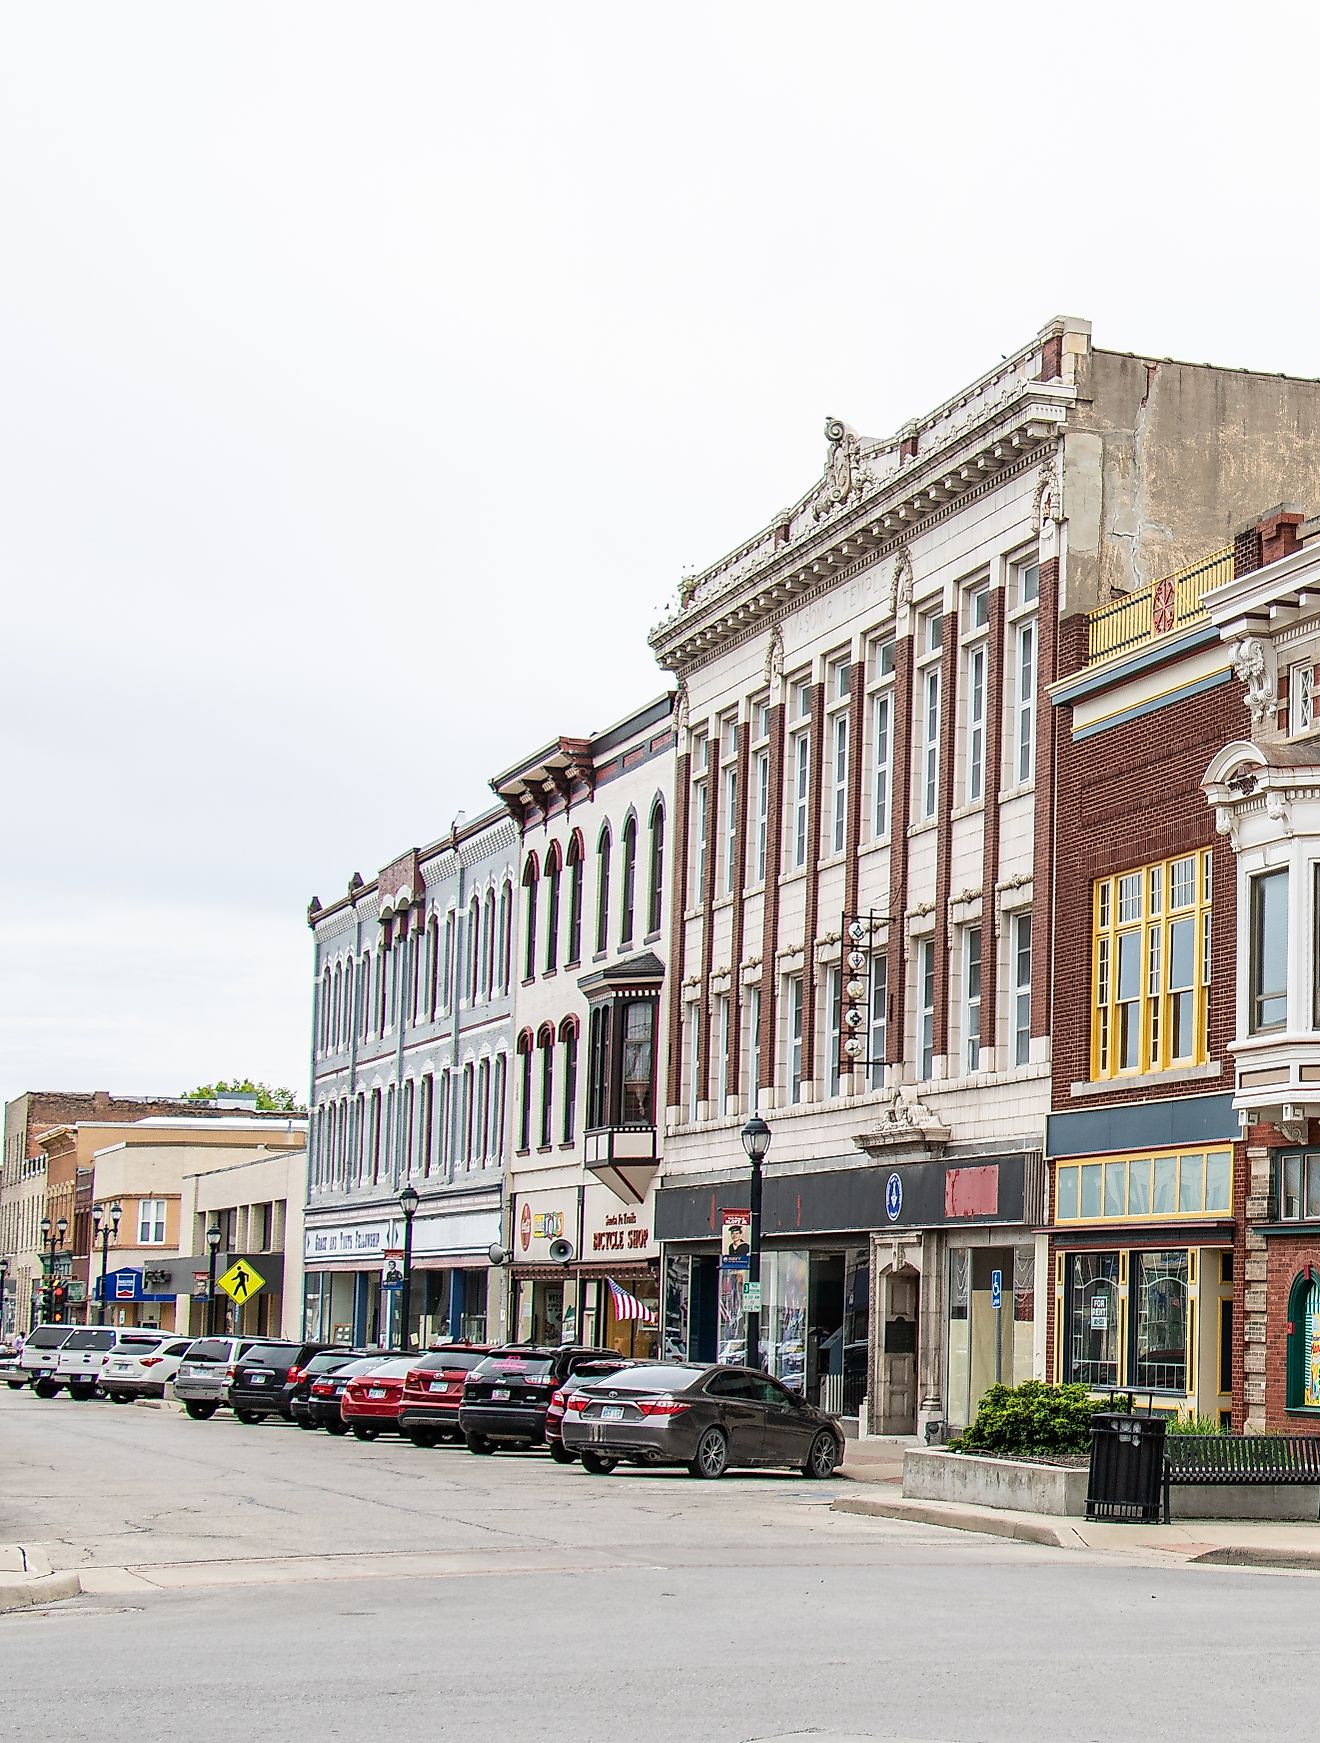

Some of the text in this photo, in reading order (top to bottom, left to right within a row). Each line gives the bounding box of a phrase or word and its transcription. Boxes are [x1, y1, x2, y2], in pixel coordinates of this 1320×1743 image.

[842, 566, 888, 610] TEMPLE
[593, 1228, 649, 1251] BICYCLE SHOP
[1093, 1299, 1105, 1308] FOR
